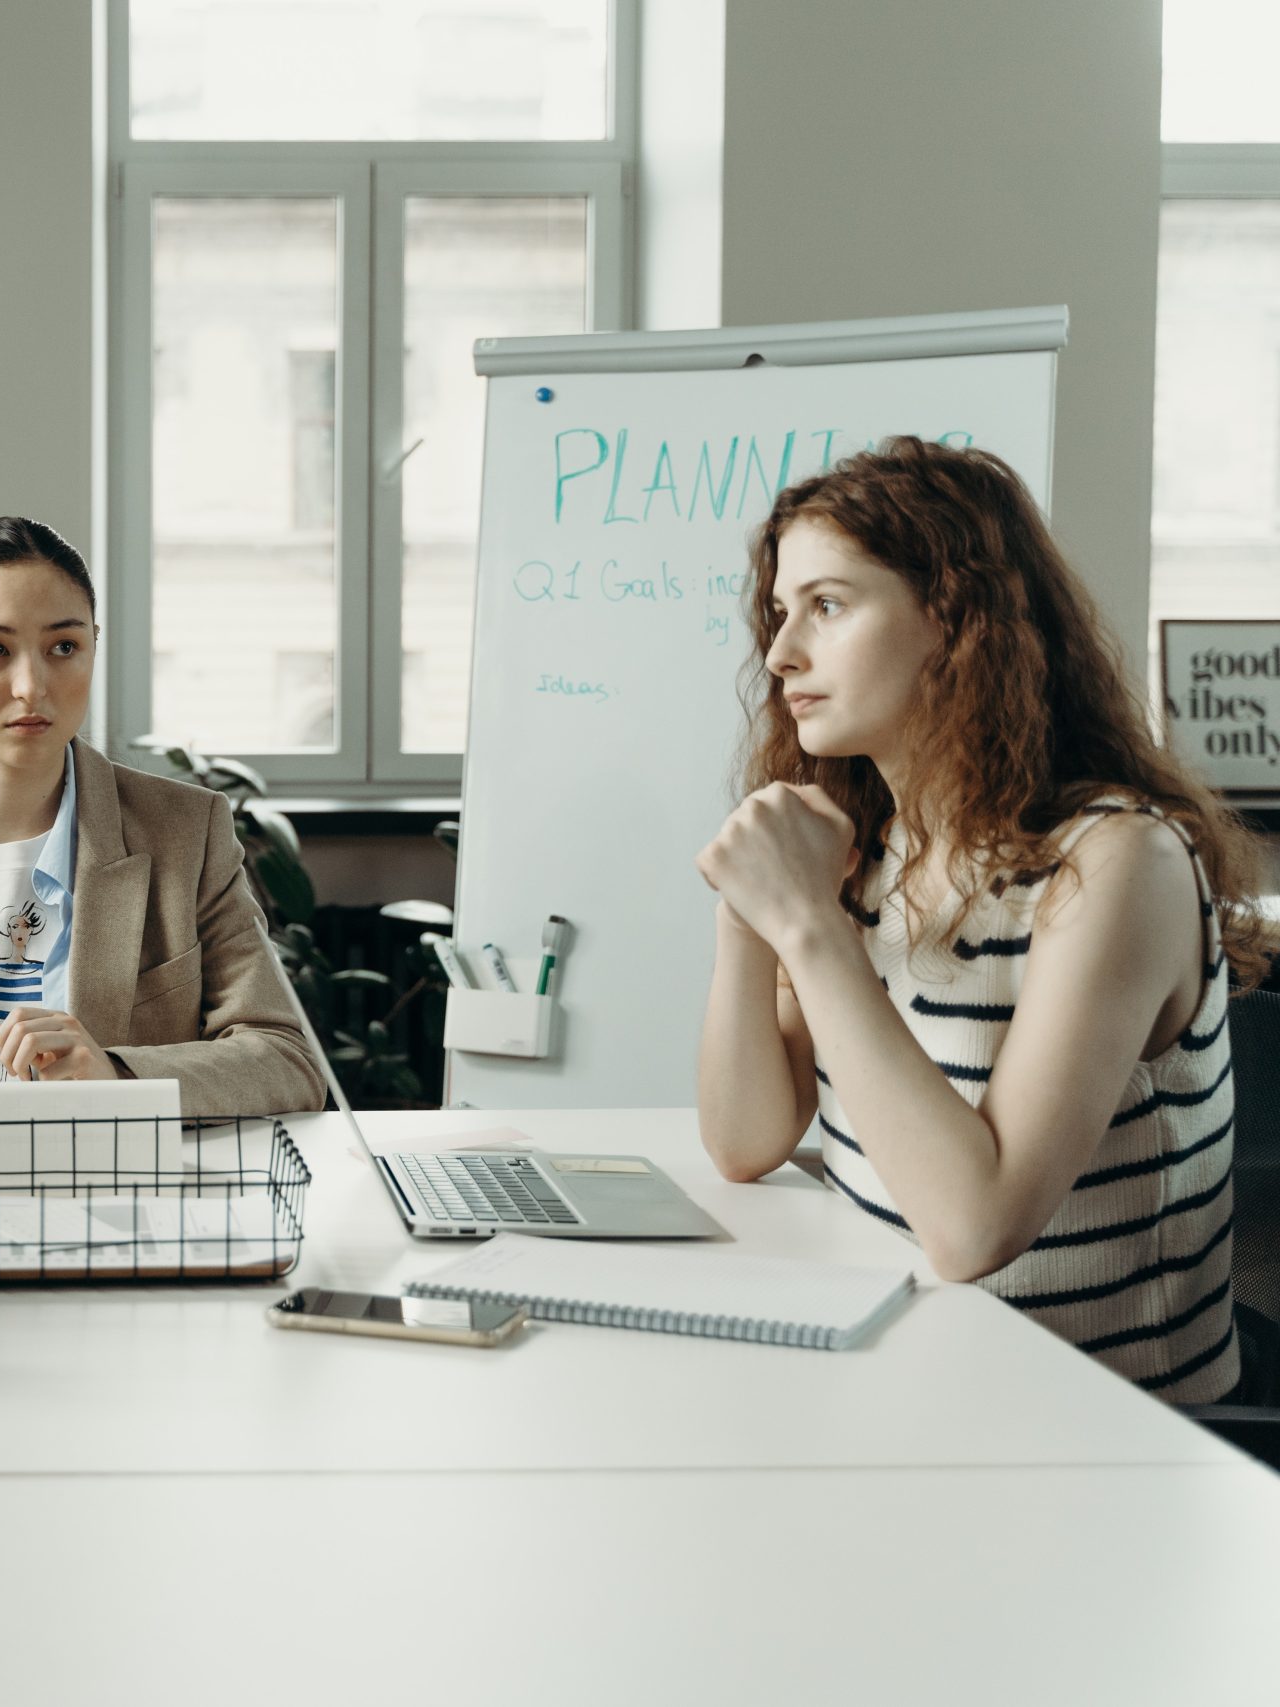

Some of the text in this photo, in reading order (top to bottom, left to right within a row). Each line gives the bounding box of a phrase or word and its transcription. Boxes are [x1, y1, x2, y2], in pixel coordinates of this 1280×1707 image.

[554, 428, 974, 525] PLANNI
[513, 560, 581, 602] Q1
[704, 603, 730, 647] by
[1190, 644, 1280, 687] good
